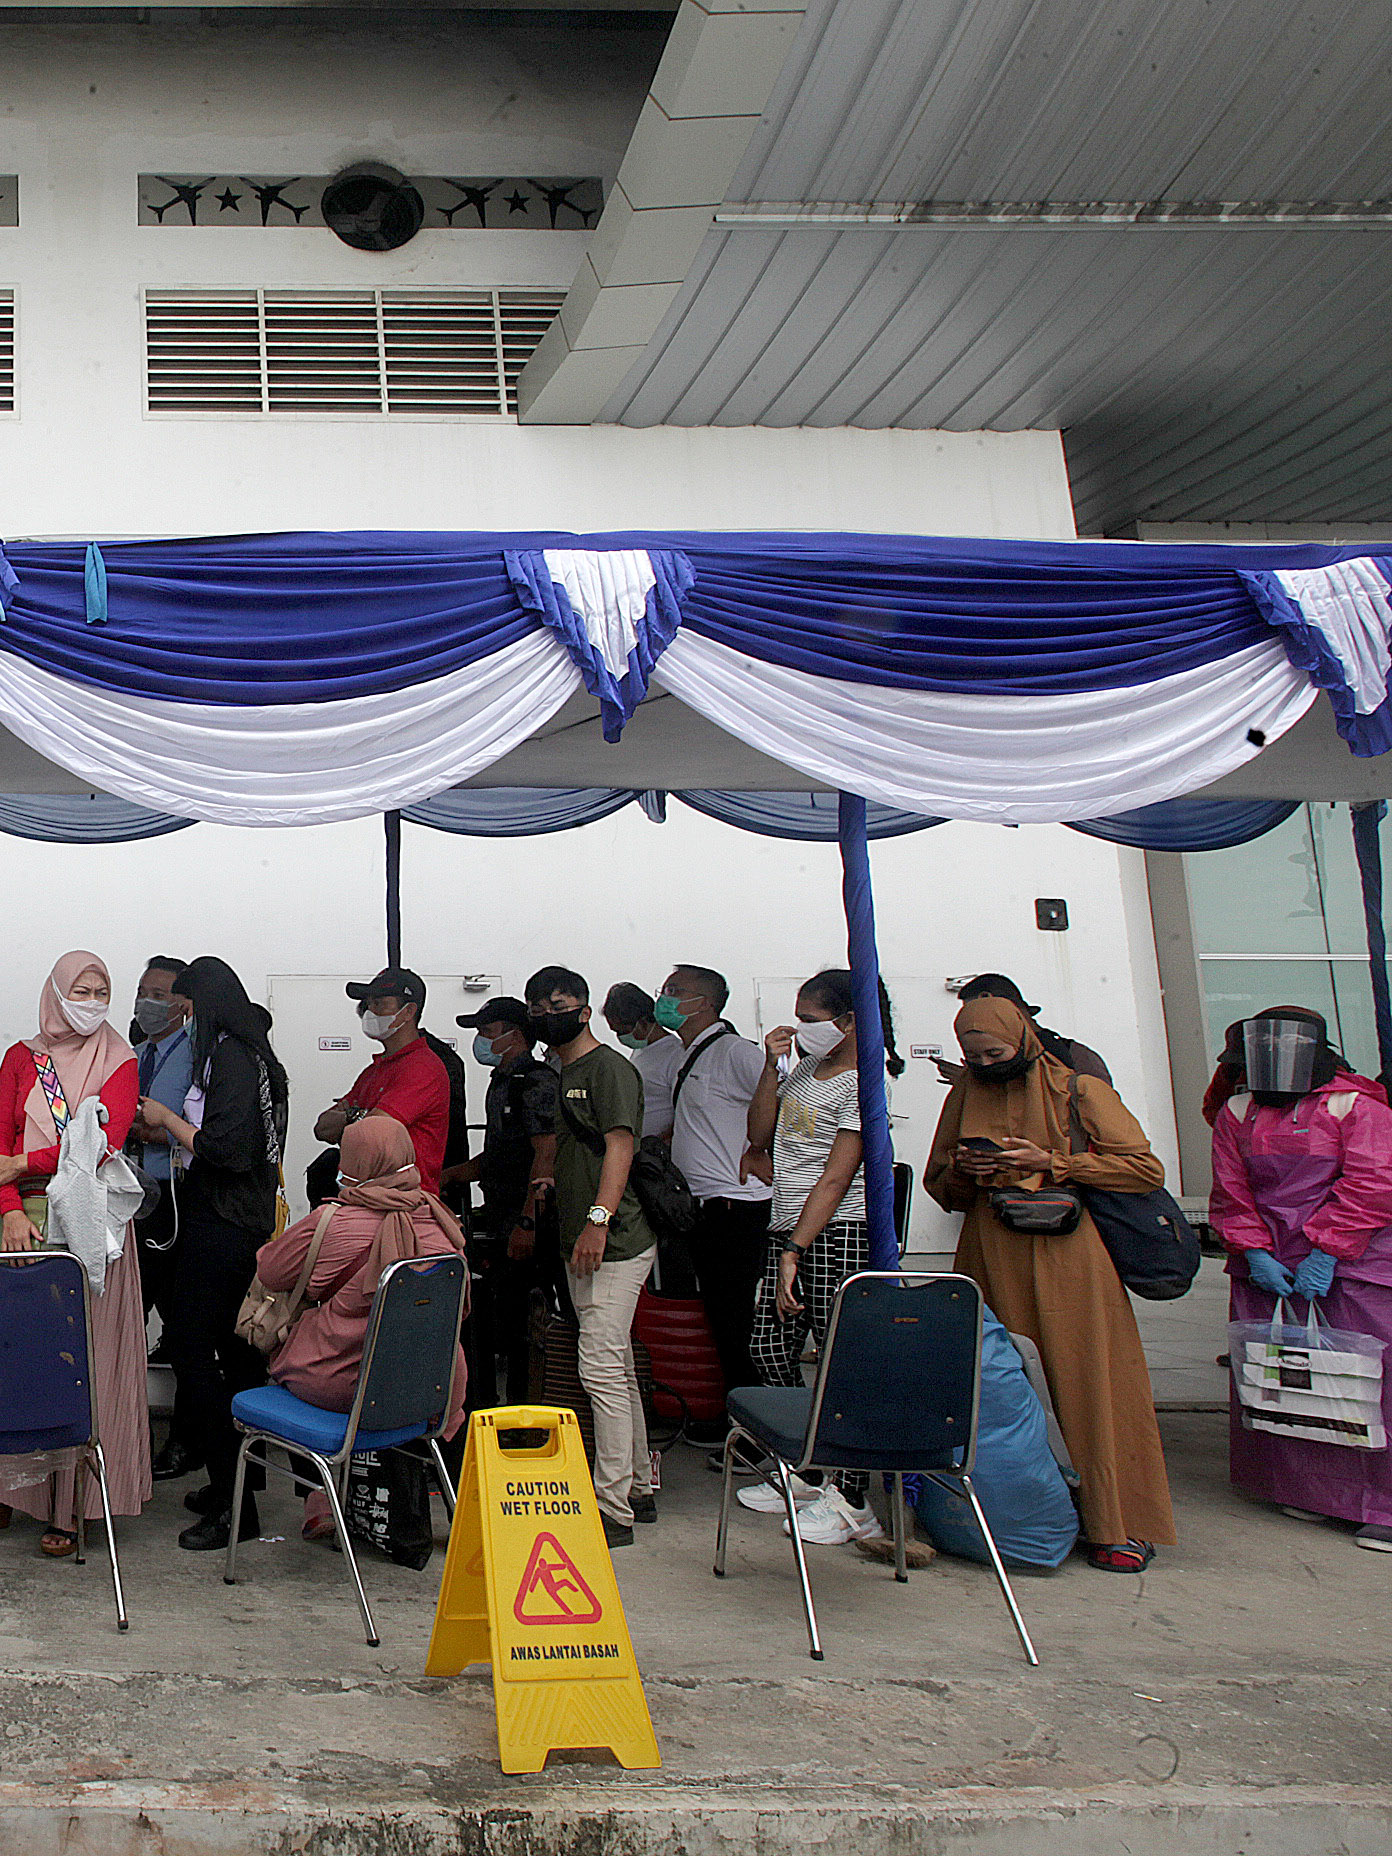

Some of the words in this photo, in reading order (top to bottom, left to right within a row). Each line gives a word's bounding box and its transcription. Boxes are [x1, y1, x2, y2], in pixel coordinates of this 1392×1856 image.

[506, 1481, 570, 1496] CAUTION
[500, 1501, 530, 1516] WET
[534, 1500, 582, 1515] FLOOR
[510, 1646, 541, 1660] AWAS
[543, 1645, 582, 1660] LANTAI
[584, 1644, 620, 1658] BASAH
